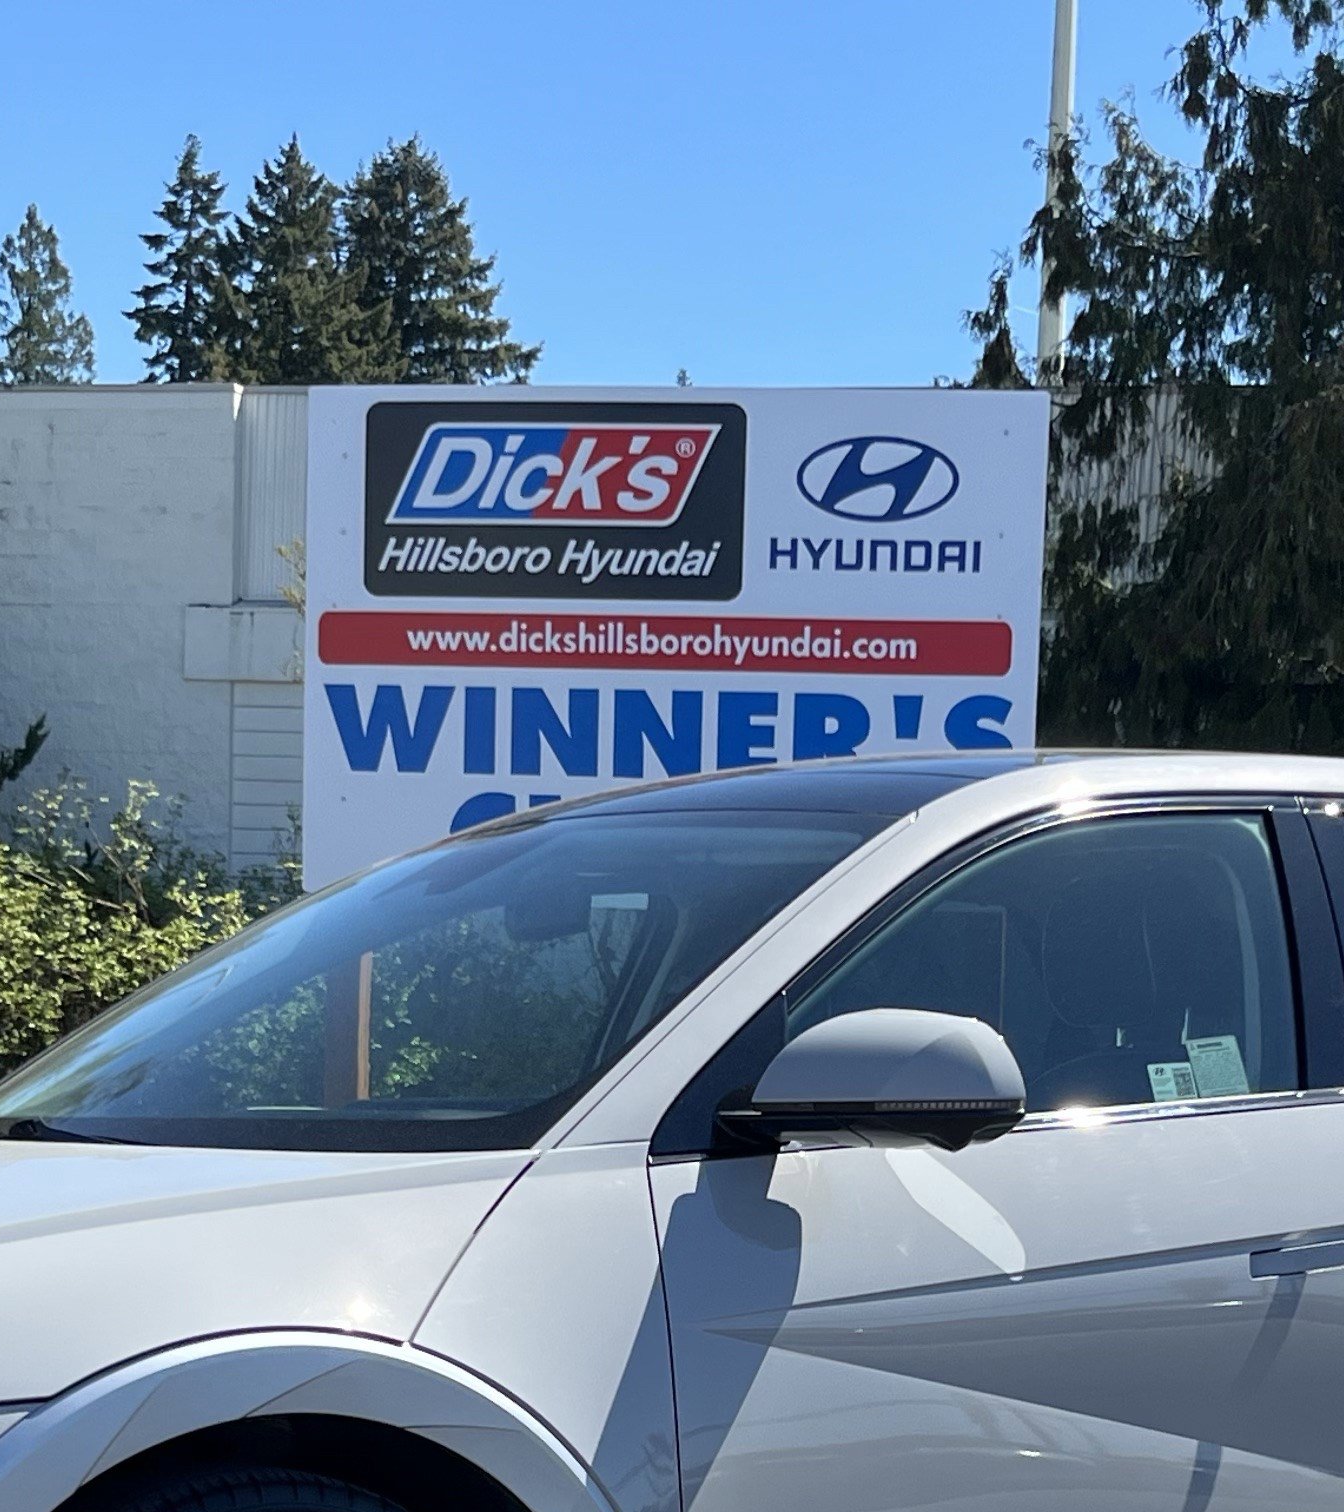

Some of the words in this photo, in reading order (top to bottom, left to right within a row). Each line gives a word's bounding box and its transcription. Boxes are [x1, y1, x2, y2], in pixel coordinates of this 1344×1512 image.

[411, 433, 680, 512] Dick's
[378, 536, 551, 575] Hillsboro
[557, 540, 721, 578] Hyundai
[769, 537, 981, 573] HYUNDAI
[406, 622, 918, 665] www.dickshillsborohyundai.com
[324, 683, 1015, 778] WINNER'S
